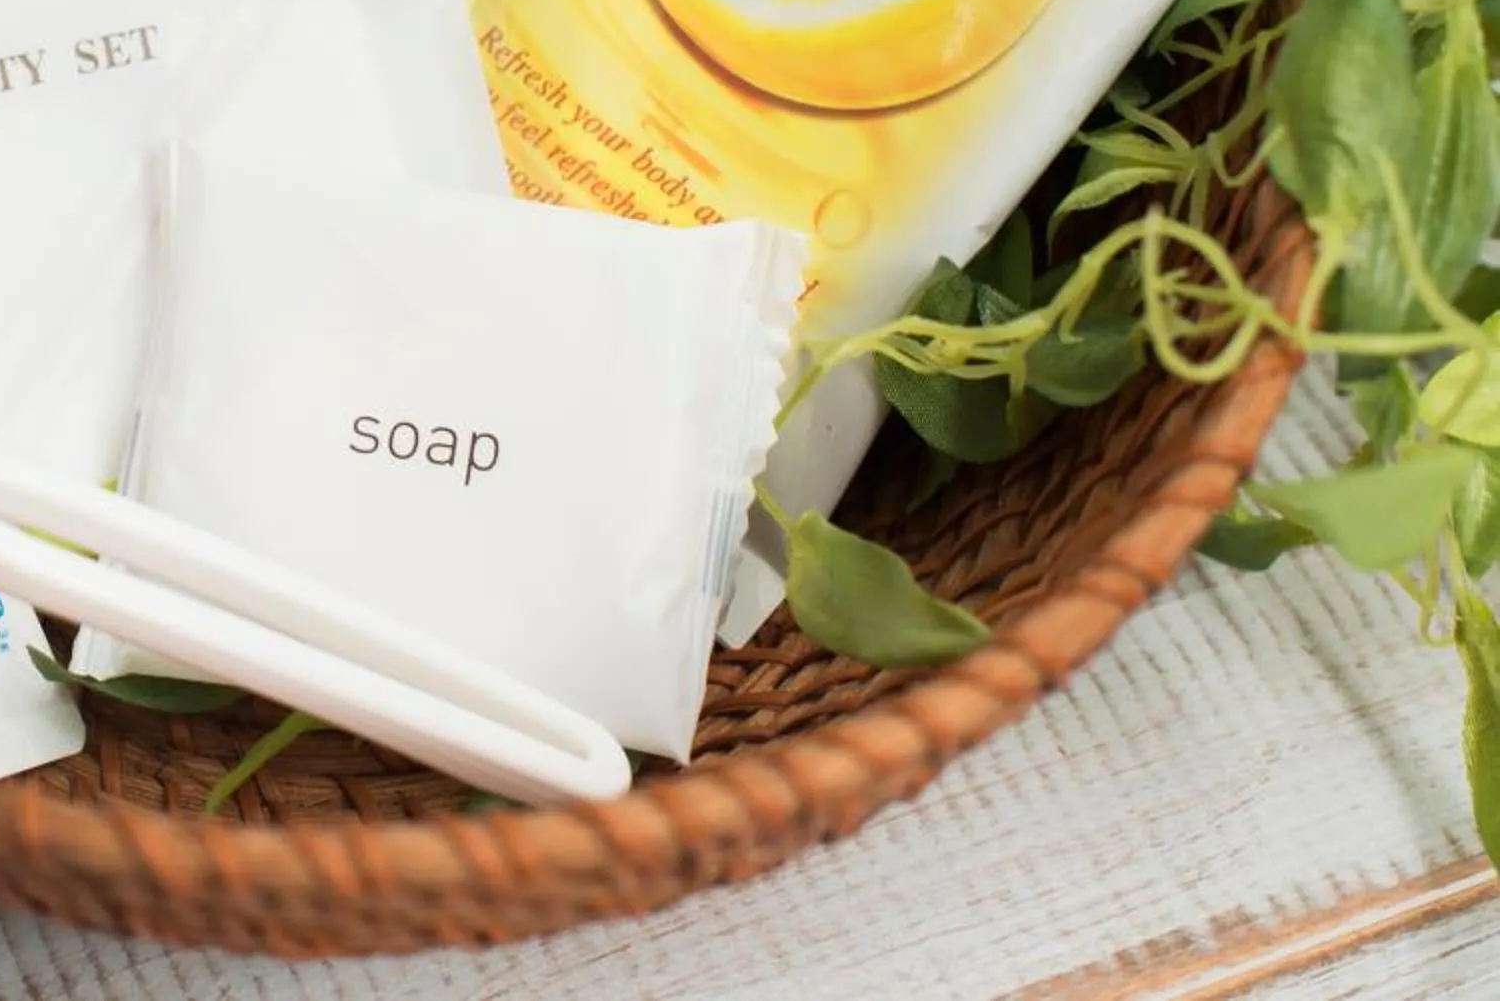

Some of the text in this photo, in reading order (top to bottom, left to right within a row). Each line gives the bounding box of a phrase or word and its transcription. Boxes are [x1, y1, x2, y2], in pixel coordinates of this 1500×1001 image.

[73, 24, 159, 76] SET
[478, 25, 569, 109] Refresh
[561, 103, 633, 153] your
[630, 147, 697, 209] body
[497, 100, 670, 226] feel refreshe
[348, 415, 500, 487] soap
